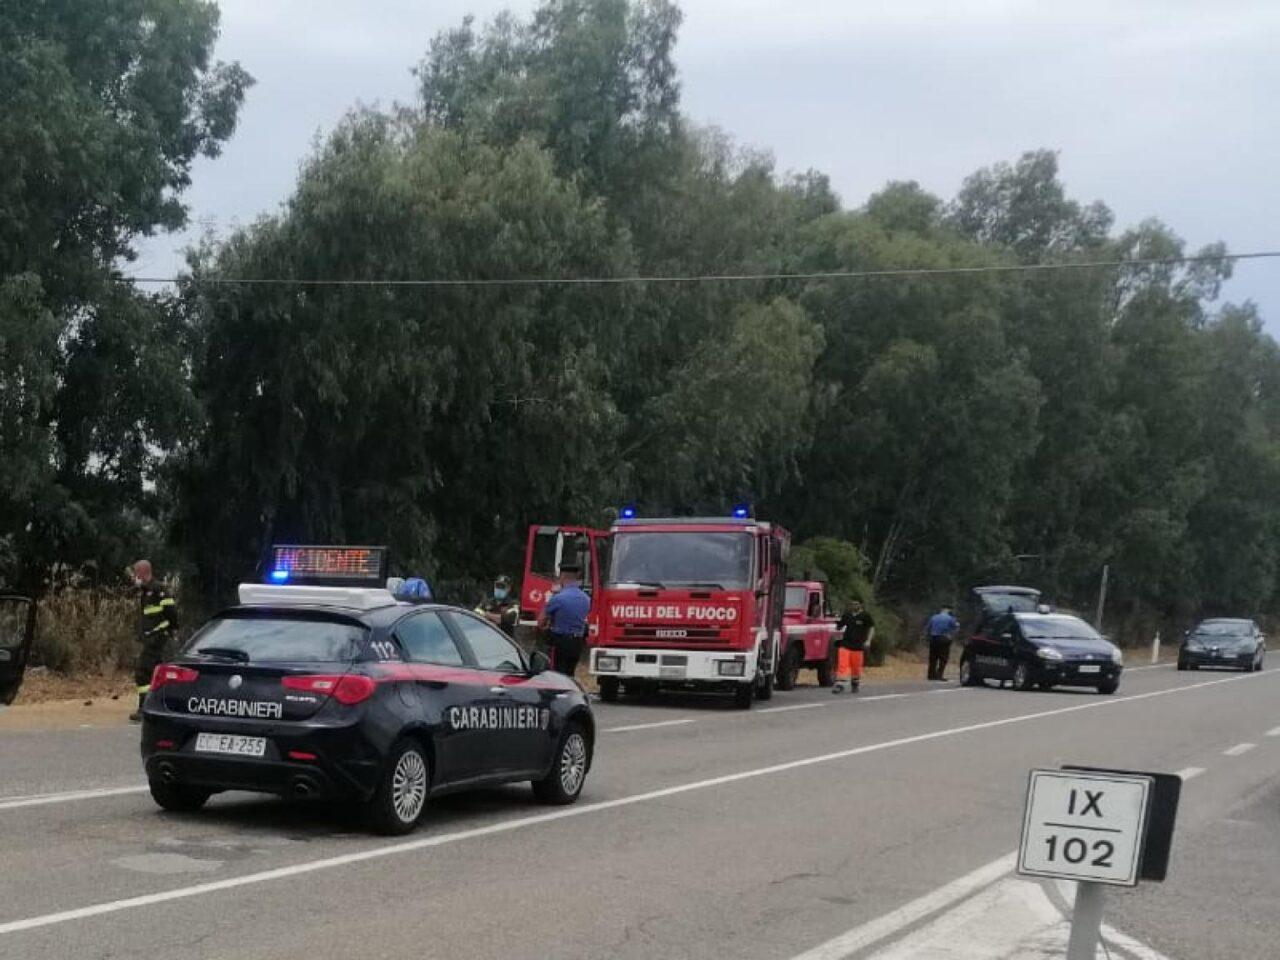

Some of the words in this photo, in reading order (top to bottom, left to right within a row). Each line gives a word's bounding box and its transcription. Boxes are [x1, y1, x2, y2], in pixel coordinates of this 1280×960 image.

[276, 549, 370, 572] INCIDENTE
[611, 605, 652, 618] VIGILI
[656, 606, 682, 619] DEL
[687, 606, 737, 620] FUOCO
[371, 641, 399, 659] 112
[188, 697, 283, 719] CARABINIERI
[450, 707, 539, 729] CARABINIERI
[1068, 789, 1104, 818] IX
[1045, 835, 1114, 868] 102
